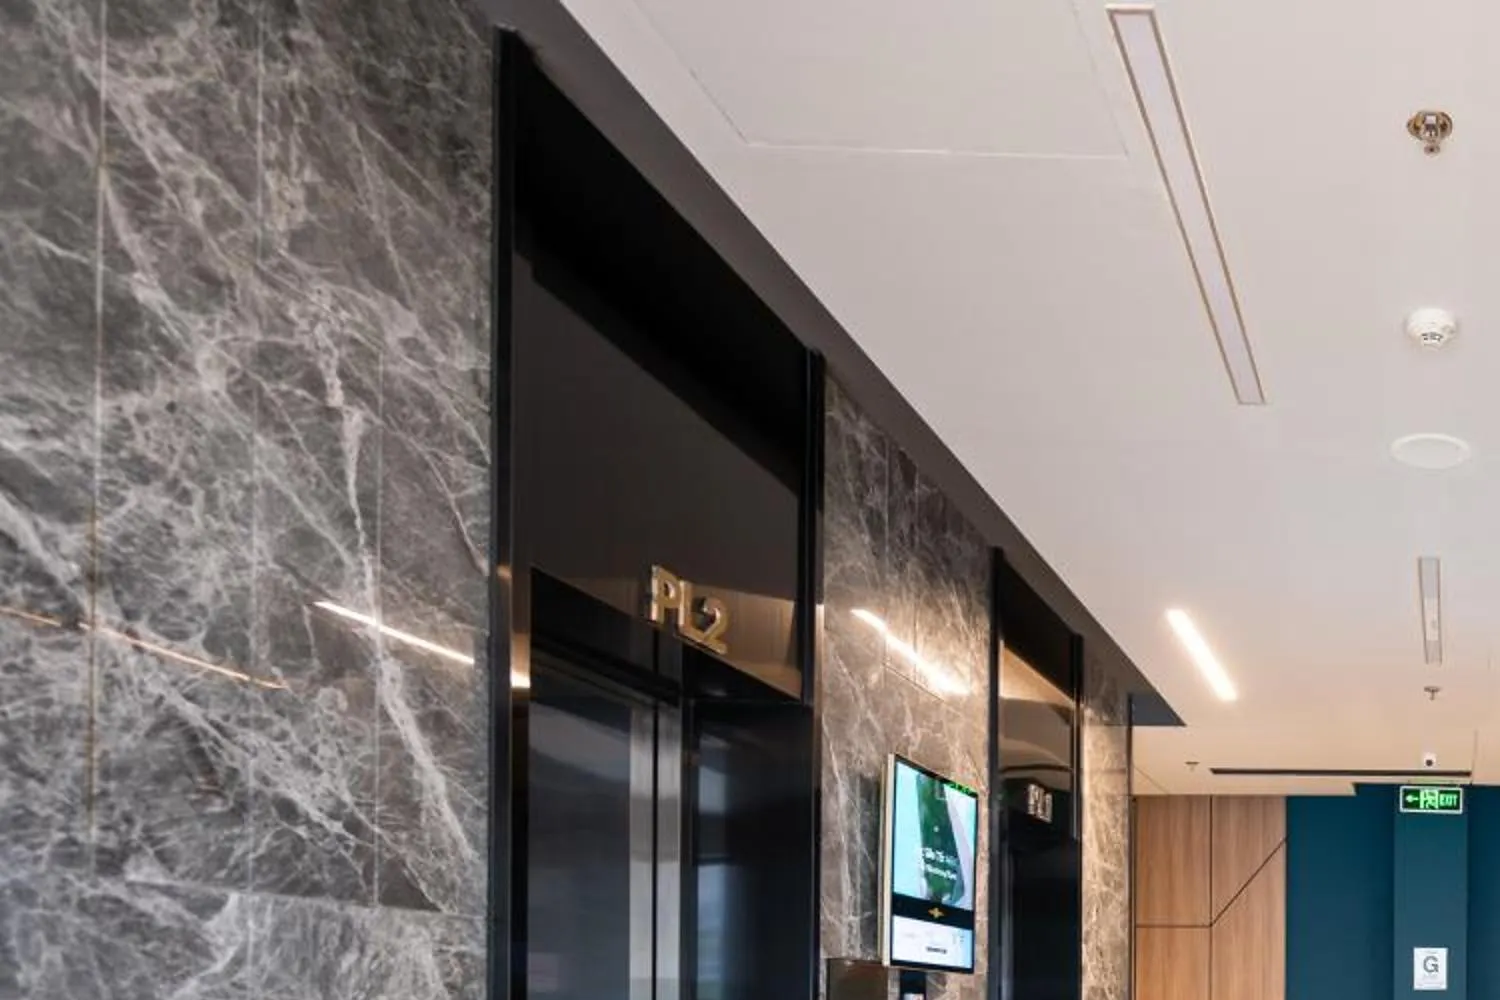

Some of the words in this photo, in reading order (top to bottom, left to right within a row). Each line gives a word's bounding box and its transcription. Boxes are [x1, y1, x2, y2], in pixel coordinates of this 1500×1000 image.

[650, 563, 728, 656] PL2
[1439, 793, 1458, 807] EXIT
[1423, 955, 1439, 973] G
